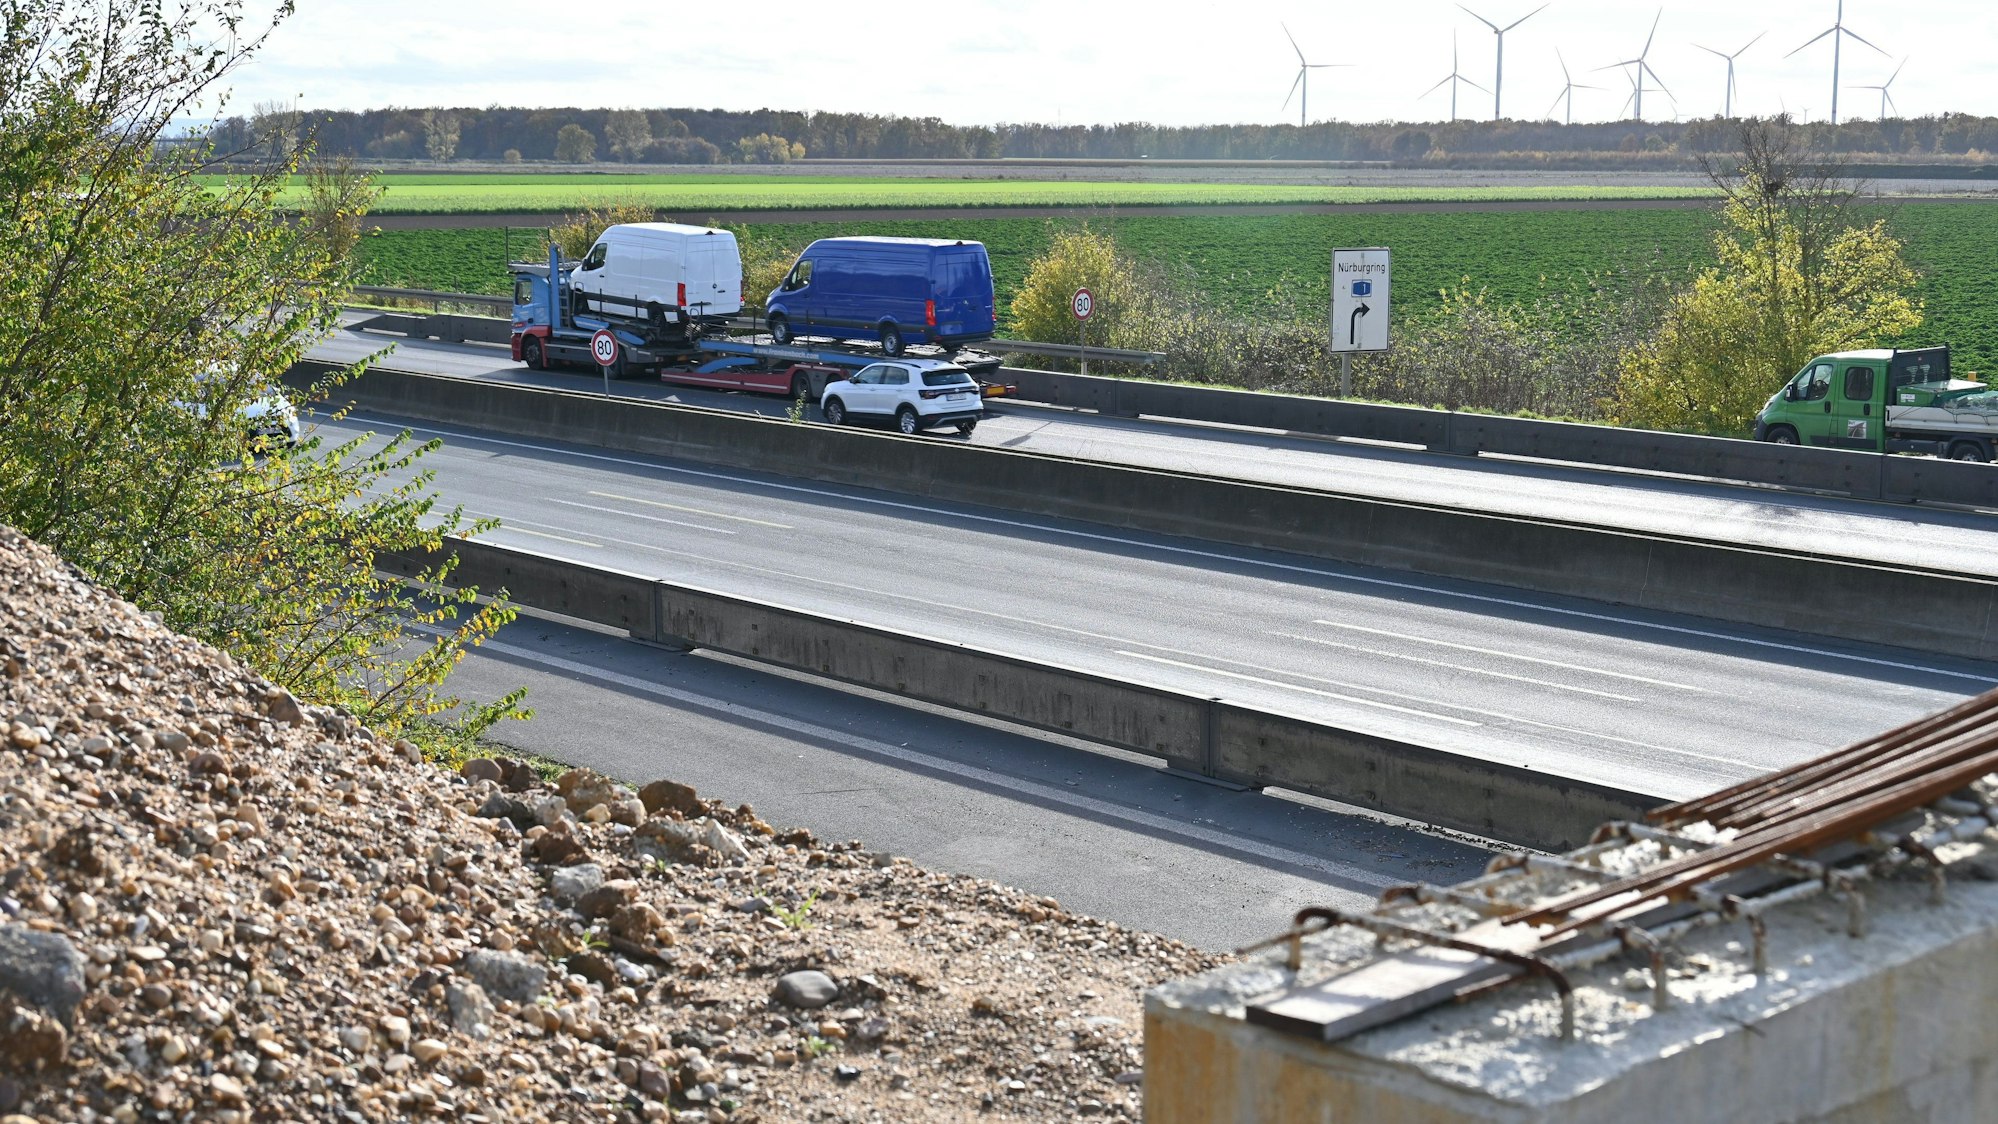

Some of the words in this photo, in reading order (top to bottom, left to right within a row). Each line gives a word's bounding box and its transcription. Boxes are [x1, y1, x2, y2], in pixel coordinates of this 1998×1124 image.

[1338, 262, 1386, 274] Nürburgring
[1077, 297, 1089, 312] 80
[597, 340, 612, 355] 80
